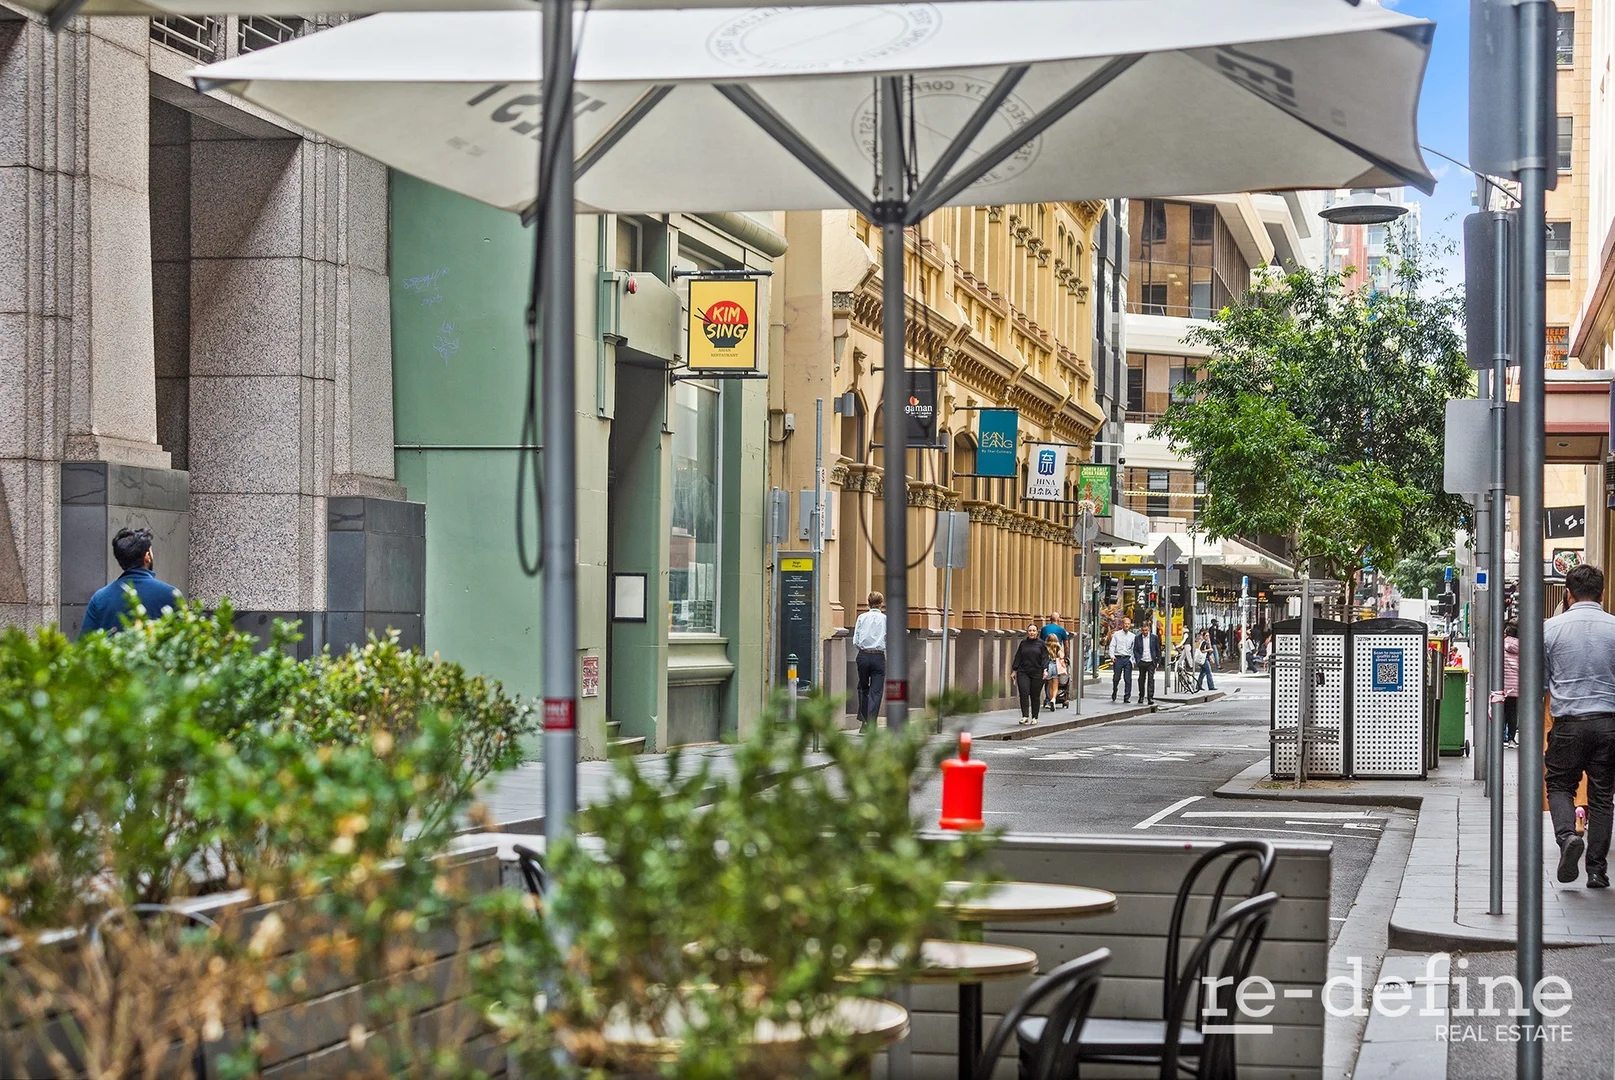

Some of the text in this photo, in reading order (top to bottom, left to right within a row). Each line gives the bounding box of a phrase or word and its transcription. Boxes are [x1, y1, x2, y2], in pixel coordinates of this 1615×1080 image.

[712, 306, 741, 323] KIM
[706, 323, 747, 340] SING
[981, 431, 1005, 441] KAN
[981, 439, 1013, 449] EANG
[1157, 621, 1182, 637] SLE
